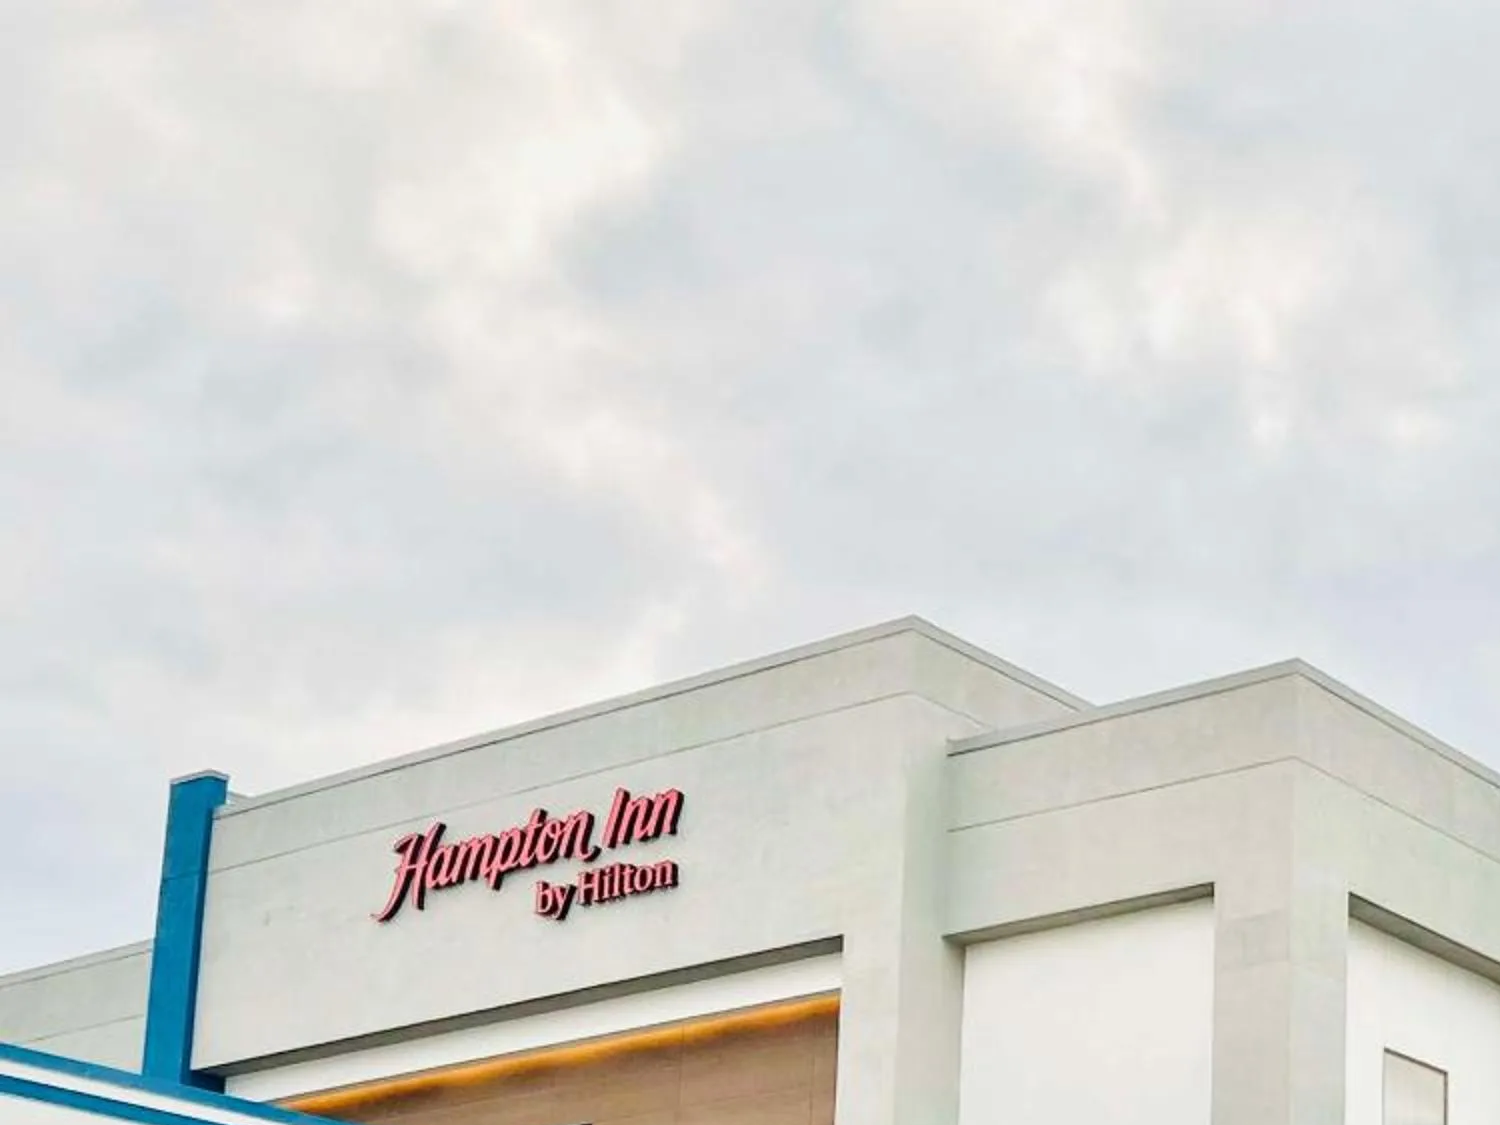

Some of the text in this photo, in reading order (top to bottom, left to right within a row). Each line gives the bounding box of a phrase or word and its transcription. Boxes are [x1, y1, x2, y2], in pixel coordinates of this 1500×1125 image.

[372, 787, 684, 922] Hampton Inn
[536, 859, 679, 920] by Hilton
